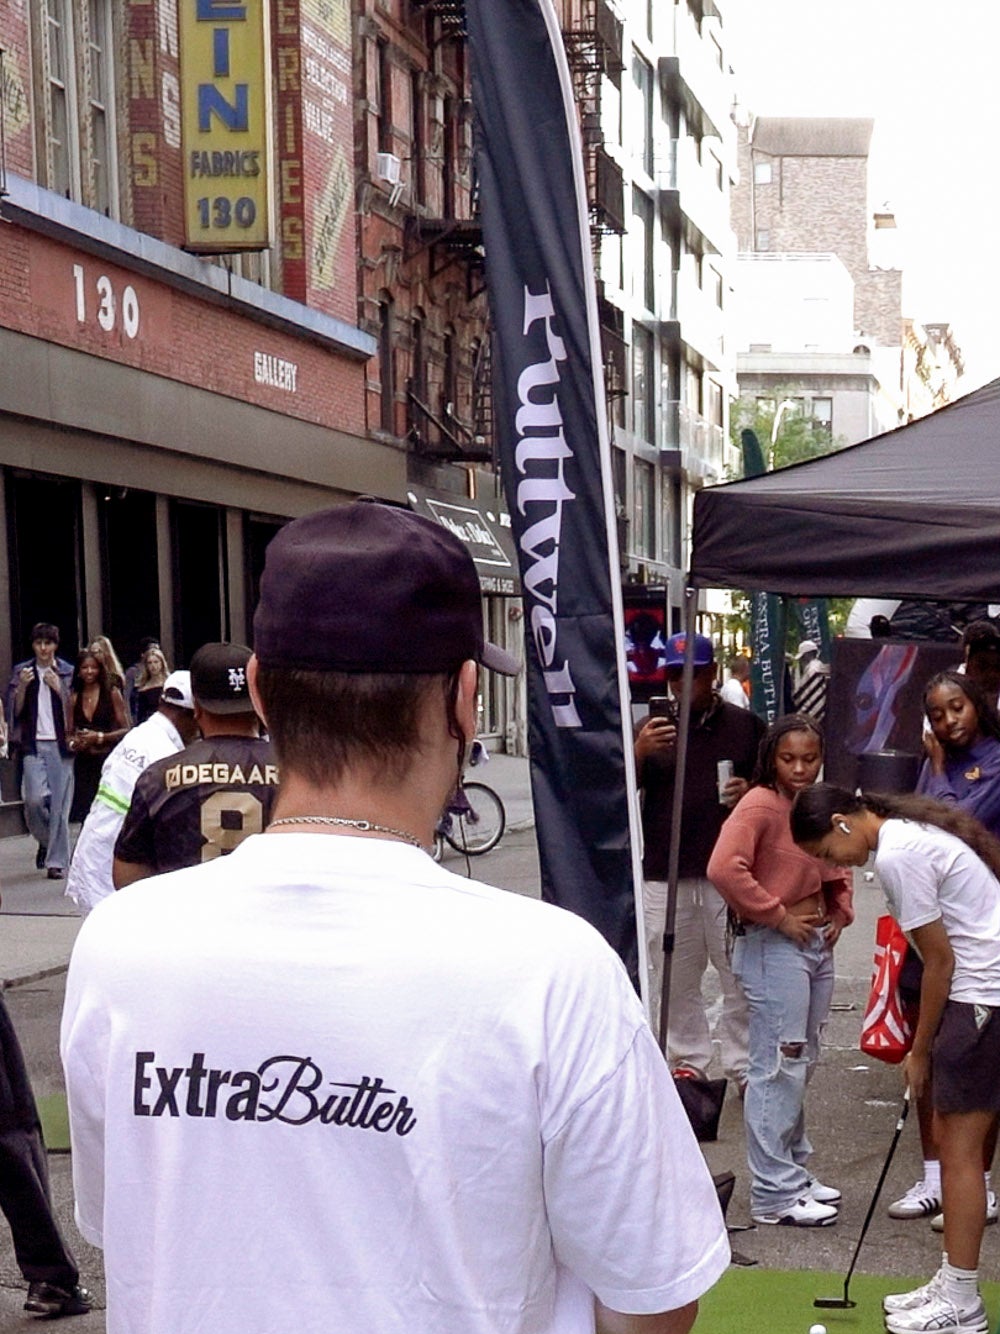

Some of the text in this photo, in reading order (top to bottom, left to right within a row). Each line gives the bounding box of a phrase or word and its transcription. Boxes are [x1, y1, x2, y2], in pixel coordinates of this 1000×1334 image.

[191, 150, 261, 178] FABRICS
[197, 196, 256, 229] 130
[73, 264, 139, 338] 130
[254, 351, 298, 393] GALLERY
[228, 667, 246, 691] NY
[761, 659, 777, 727] BUTTE
